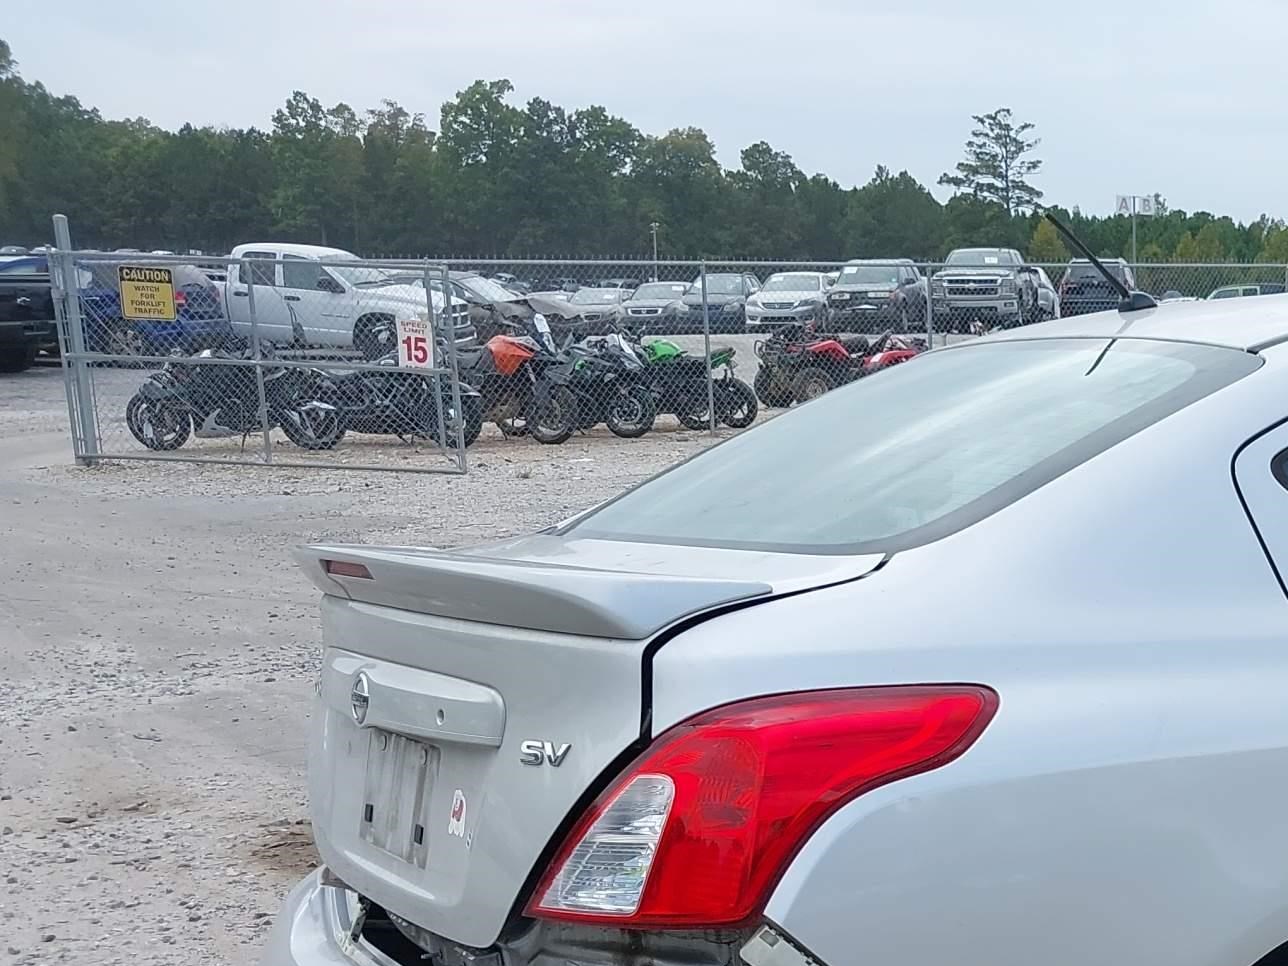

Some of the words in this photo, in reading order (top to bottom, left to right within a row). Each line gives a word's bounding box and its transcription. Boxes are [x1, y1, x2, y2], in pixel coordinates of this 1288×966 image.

[1118, 197, 1129, 211] A
[1141, 198, 1151, 212] B
[122, 269, 169, 281] CAUTION
[134, 285, 160, 293] WATCH
[140, 292, 156, 300] FOR
[130, 299, 166, 308] FORKLIFT
[134, 307, 165, 315] TRAFFIC
[400, 320, 428, 329] SPEED
[402, 336, 428, 363] 15
[520, 740, 572, 768] SV
